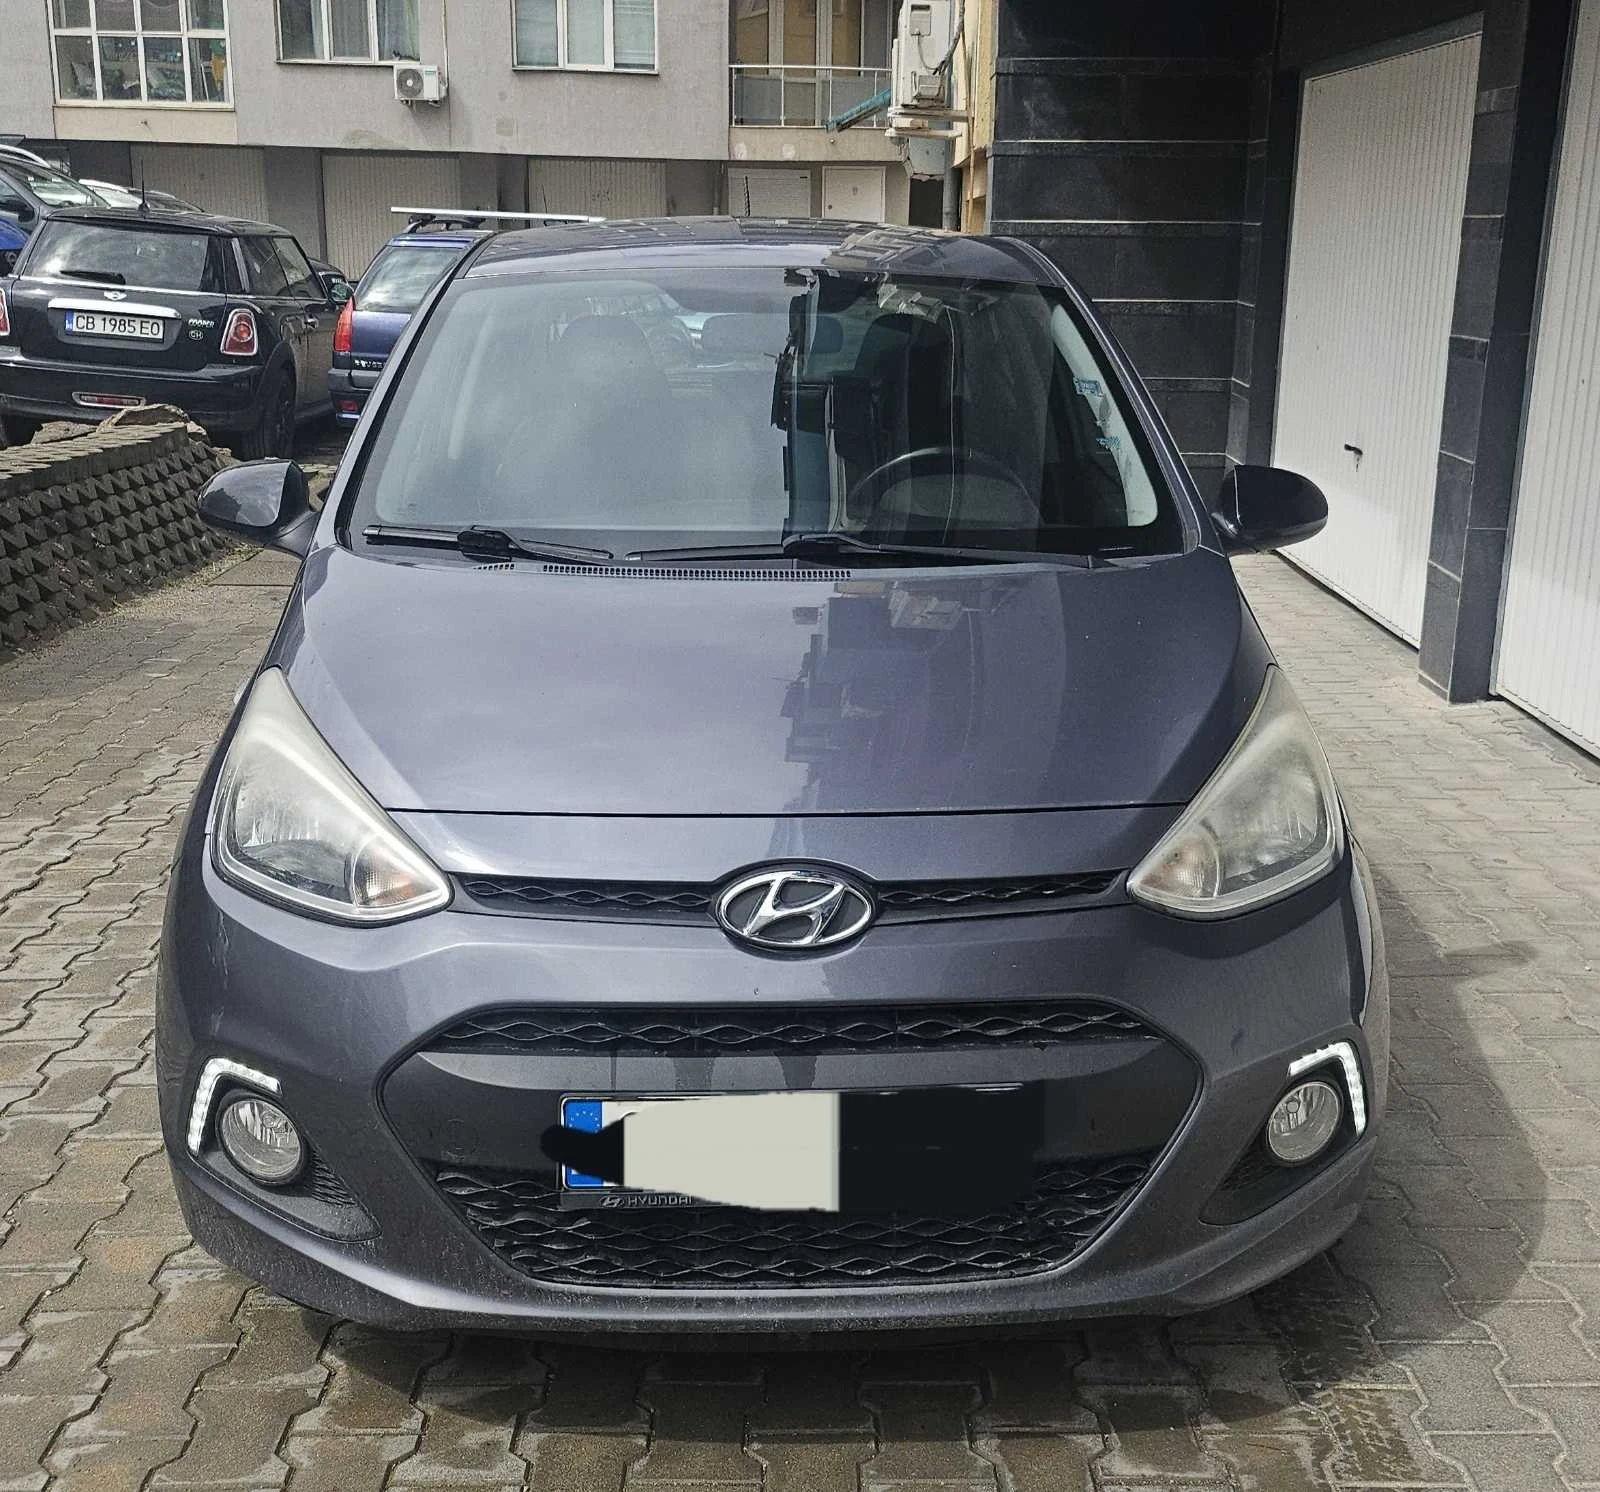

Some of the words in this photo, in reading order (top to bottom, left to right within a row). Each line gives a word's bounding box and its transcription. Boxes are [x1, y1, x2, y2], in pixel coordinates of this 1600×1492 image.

[75, 315, 96, 331] CB
[101, 317, 136, 334] 1985
[628, 1195, 692, 1206] HYUNDAI
